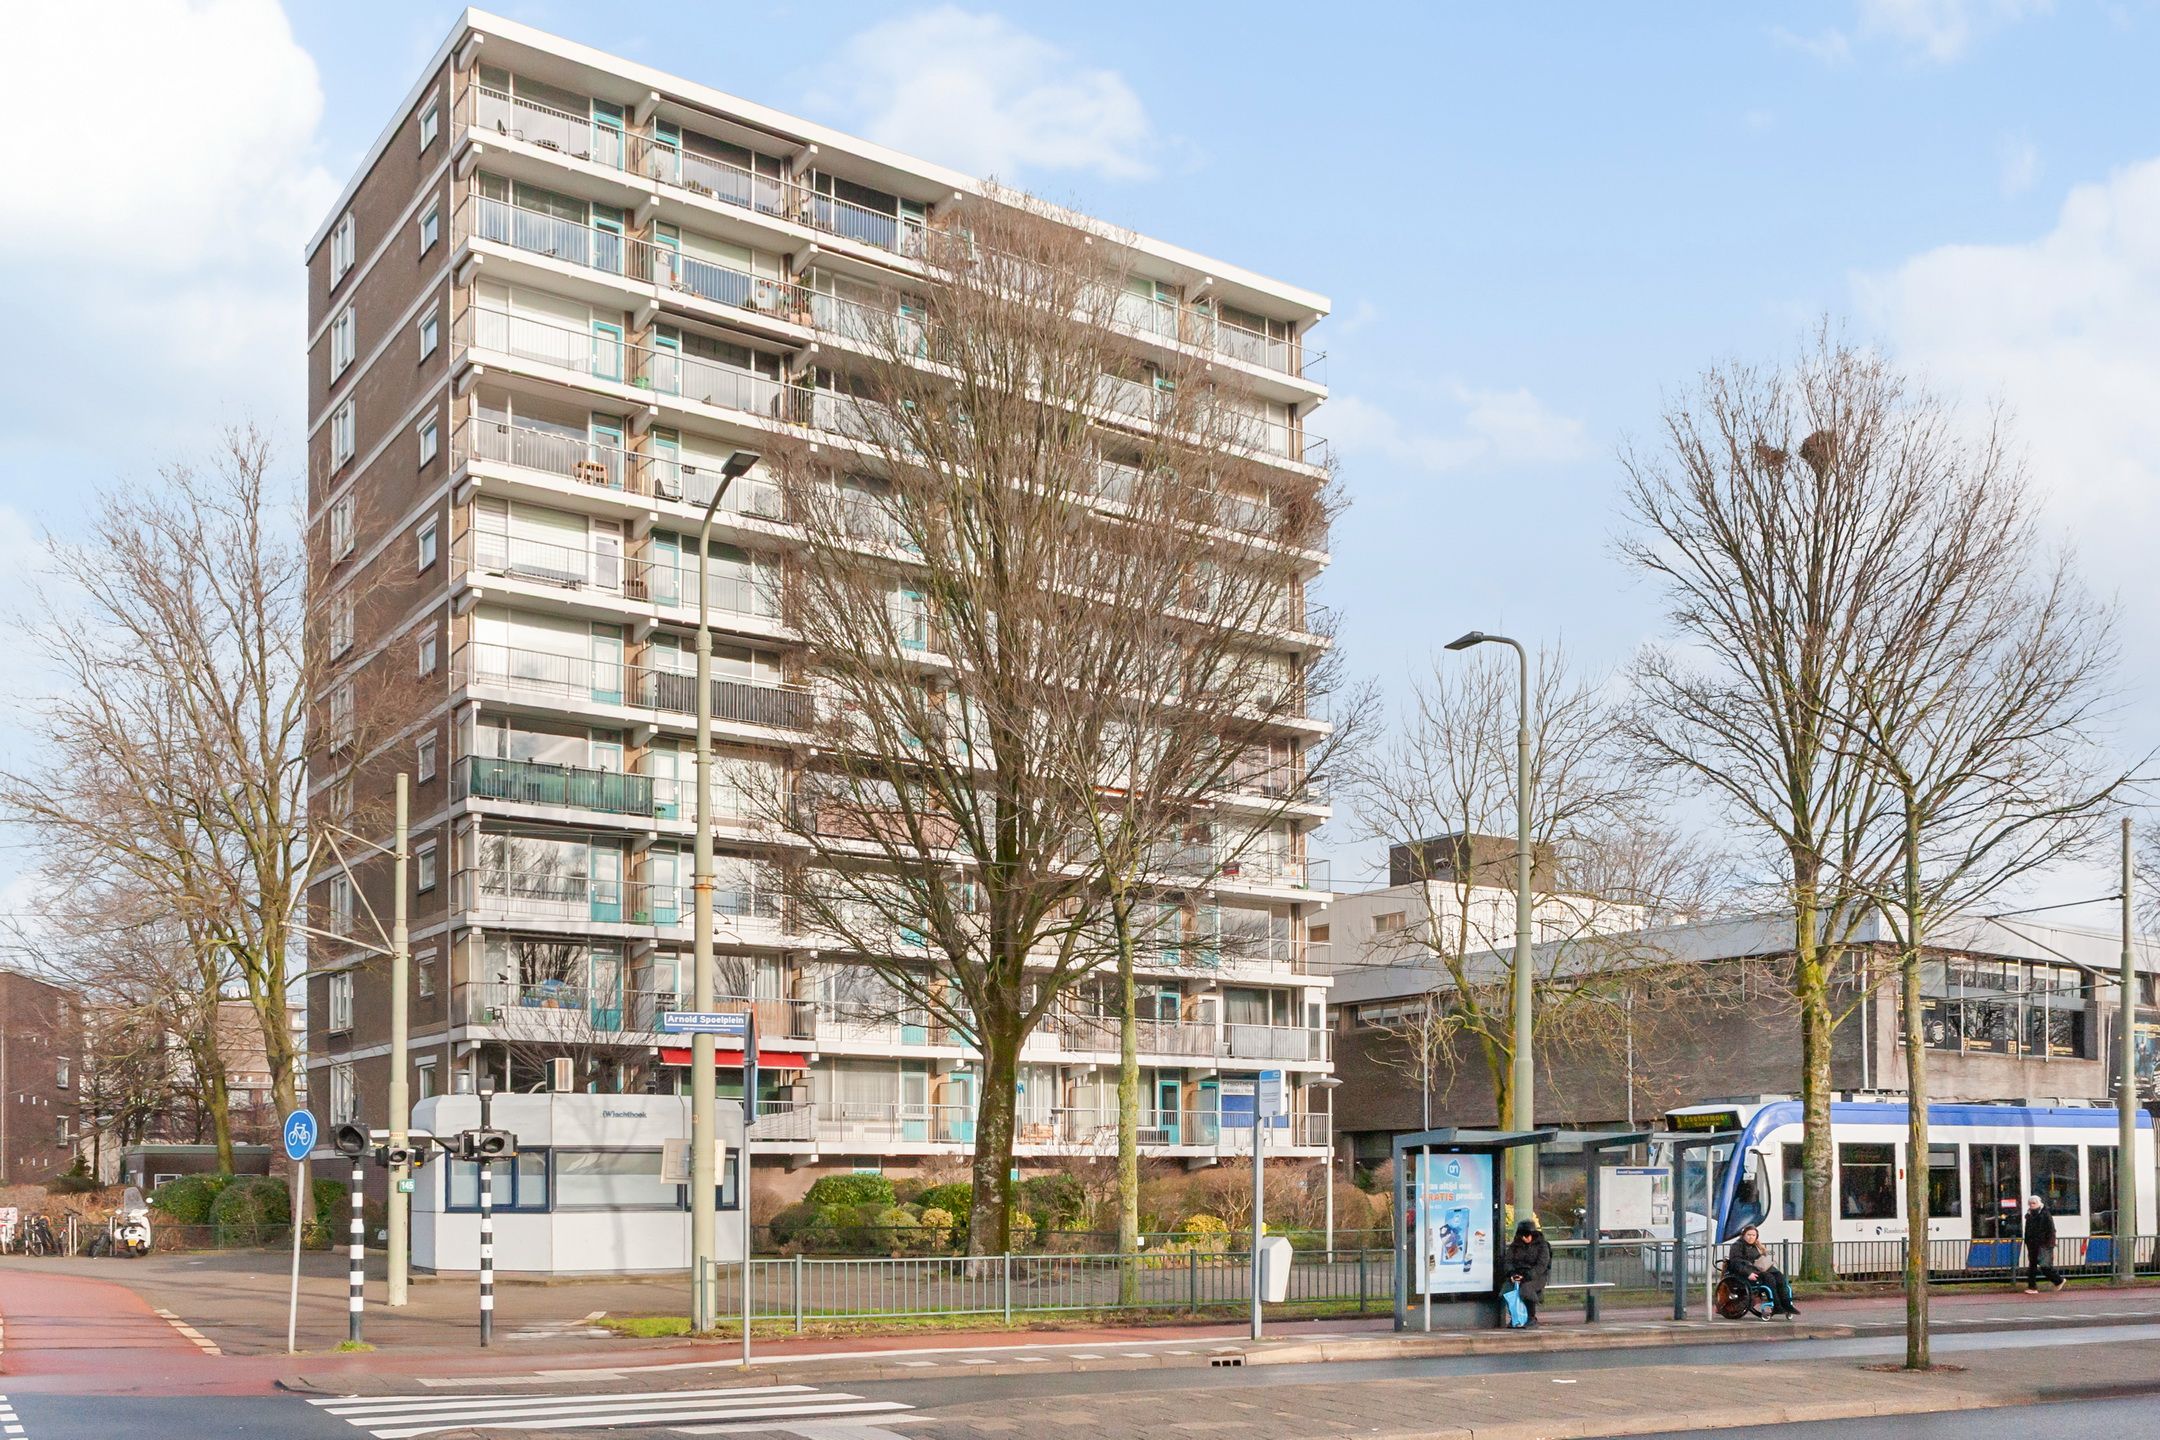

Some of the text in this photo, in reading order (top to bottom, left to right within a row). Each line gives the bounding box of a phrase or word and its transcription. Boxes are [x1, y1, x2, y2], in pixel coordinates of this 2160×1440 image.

[667, 1015, 744, 1025] Arnold Spoelplein
[401, 1181, 414, 1190] 145
